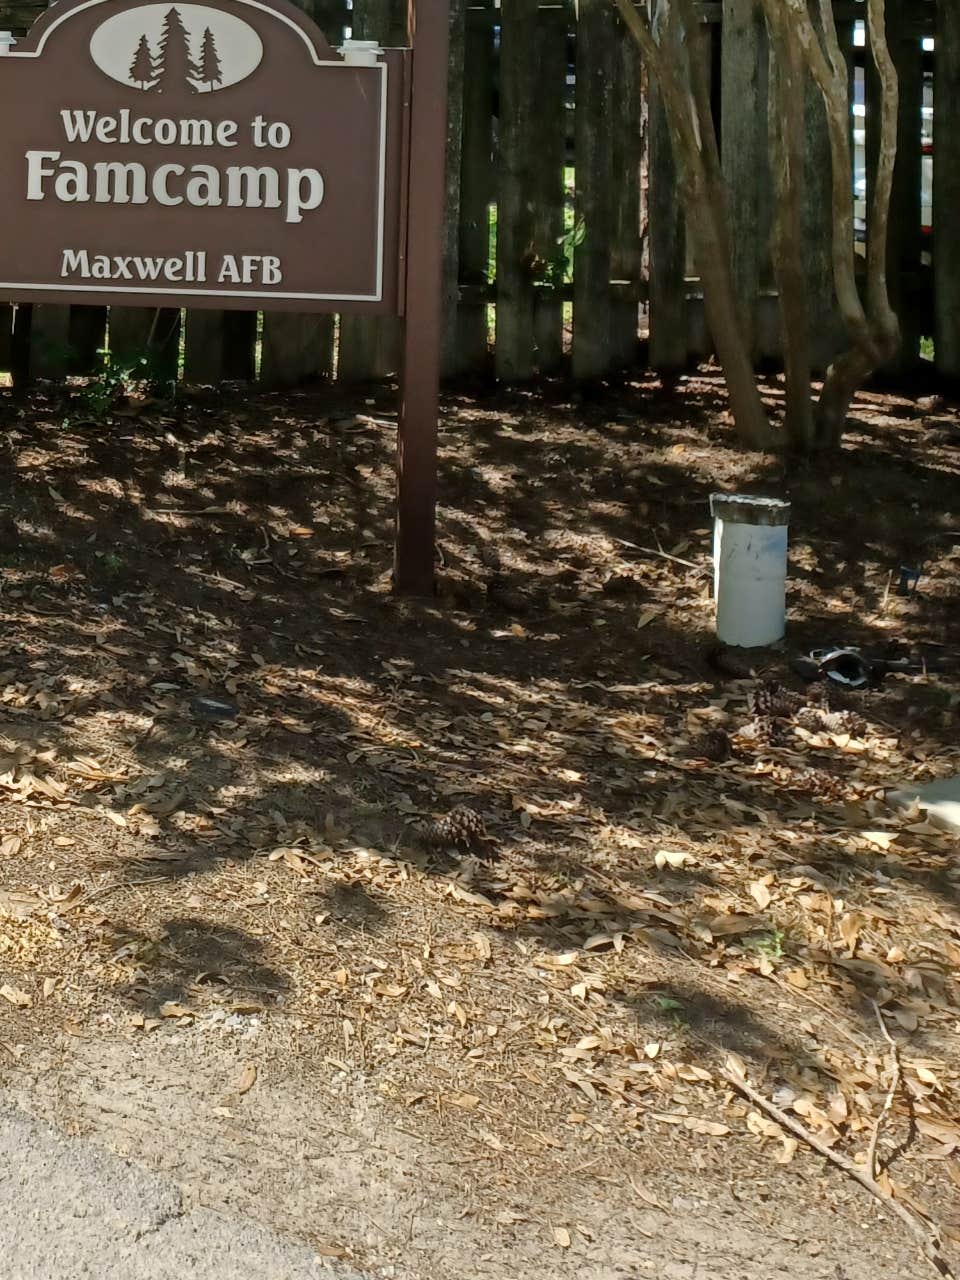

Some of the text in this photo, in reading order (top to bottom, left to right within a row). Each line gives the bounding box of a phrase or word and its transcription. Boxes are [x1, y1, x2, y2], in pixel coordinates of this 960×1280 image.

[60, 108, 291, 149] Welcome to
[25, 150, 324, 223] Famcamp
[60, 249, 283, 285] Maxwell AFB
